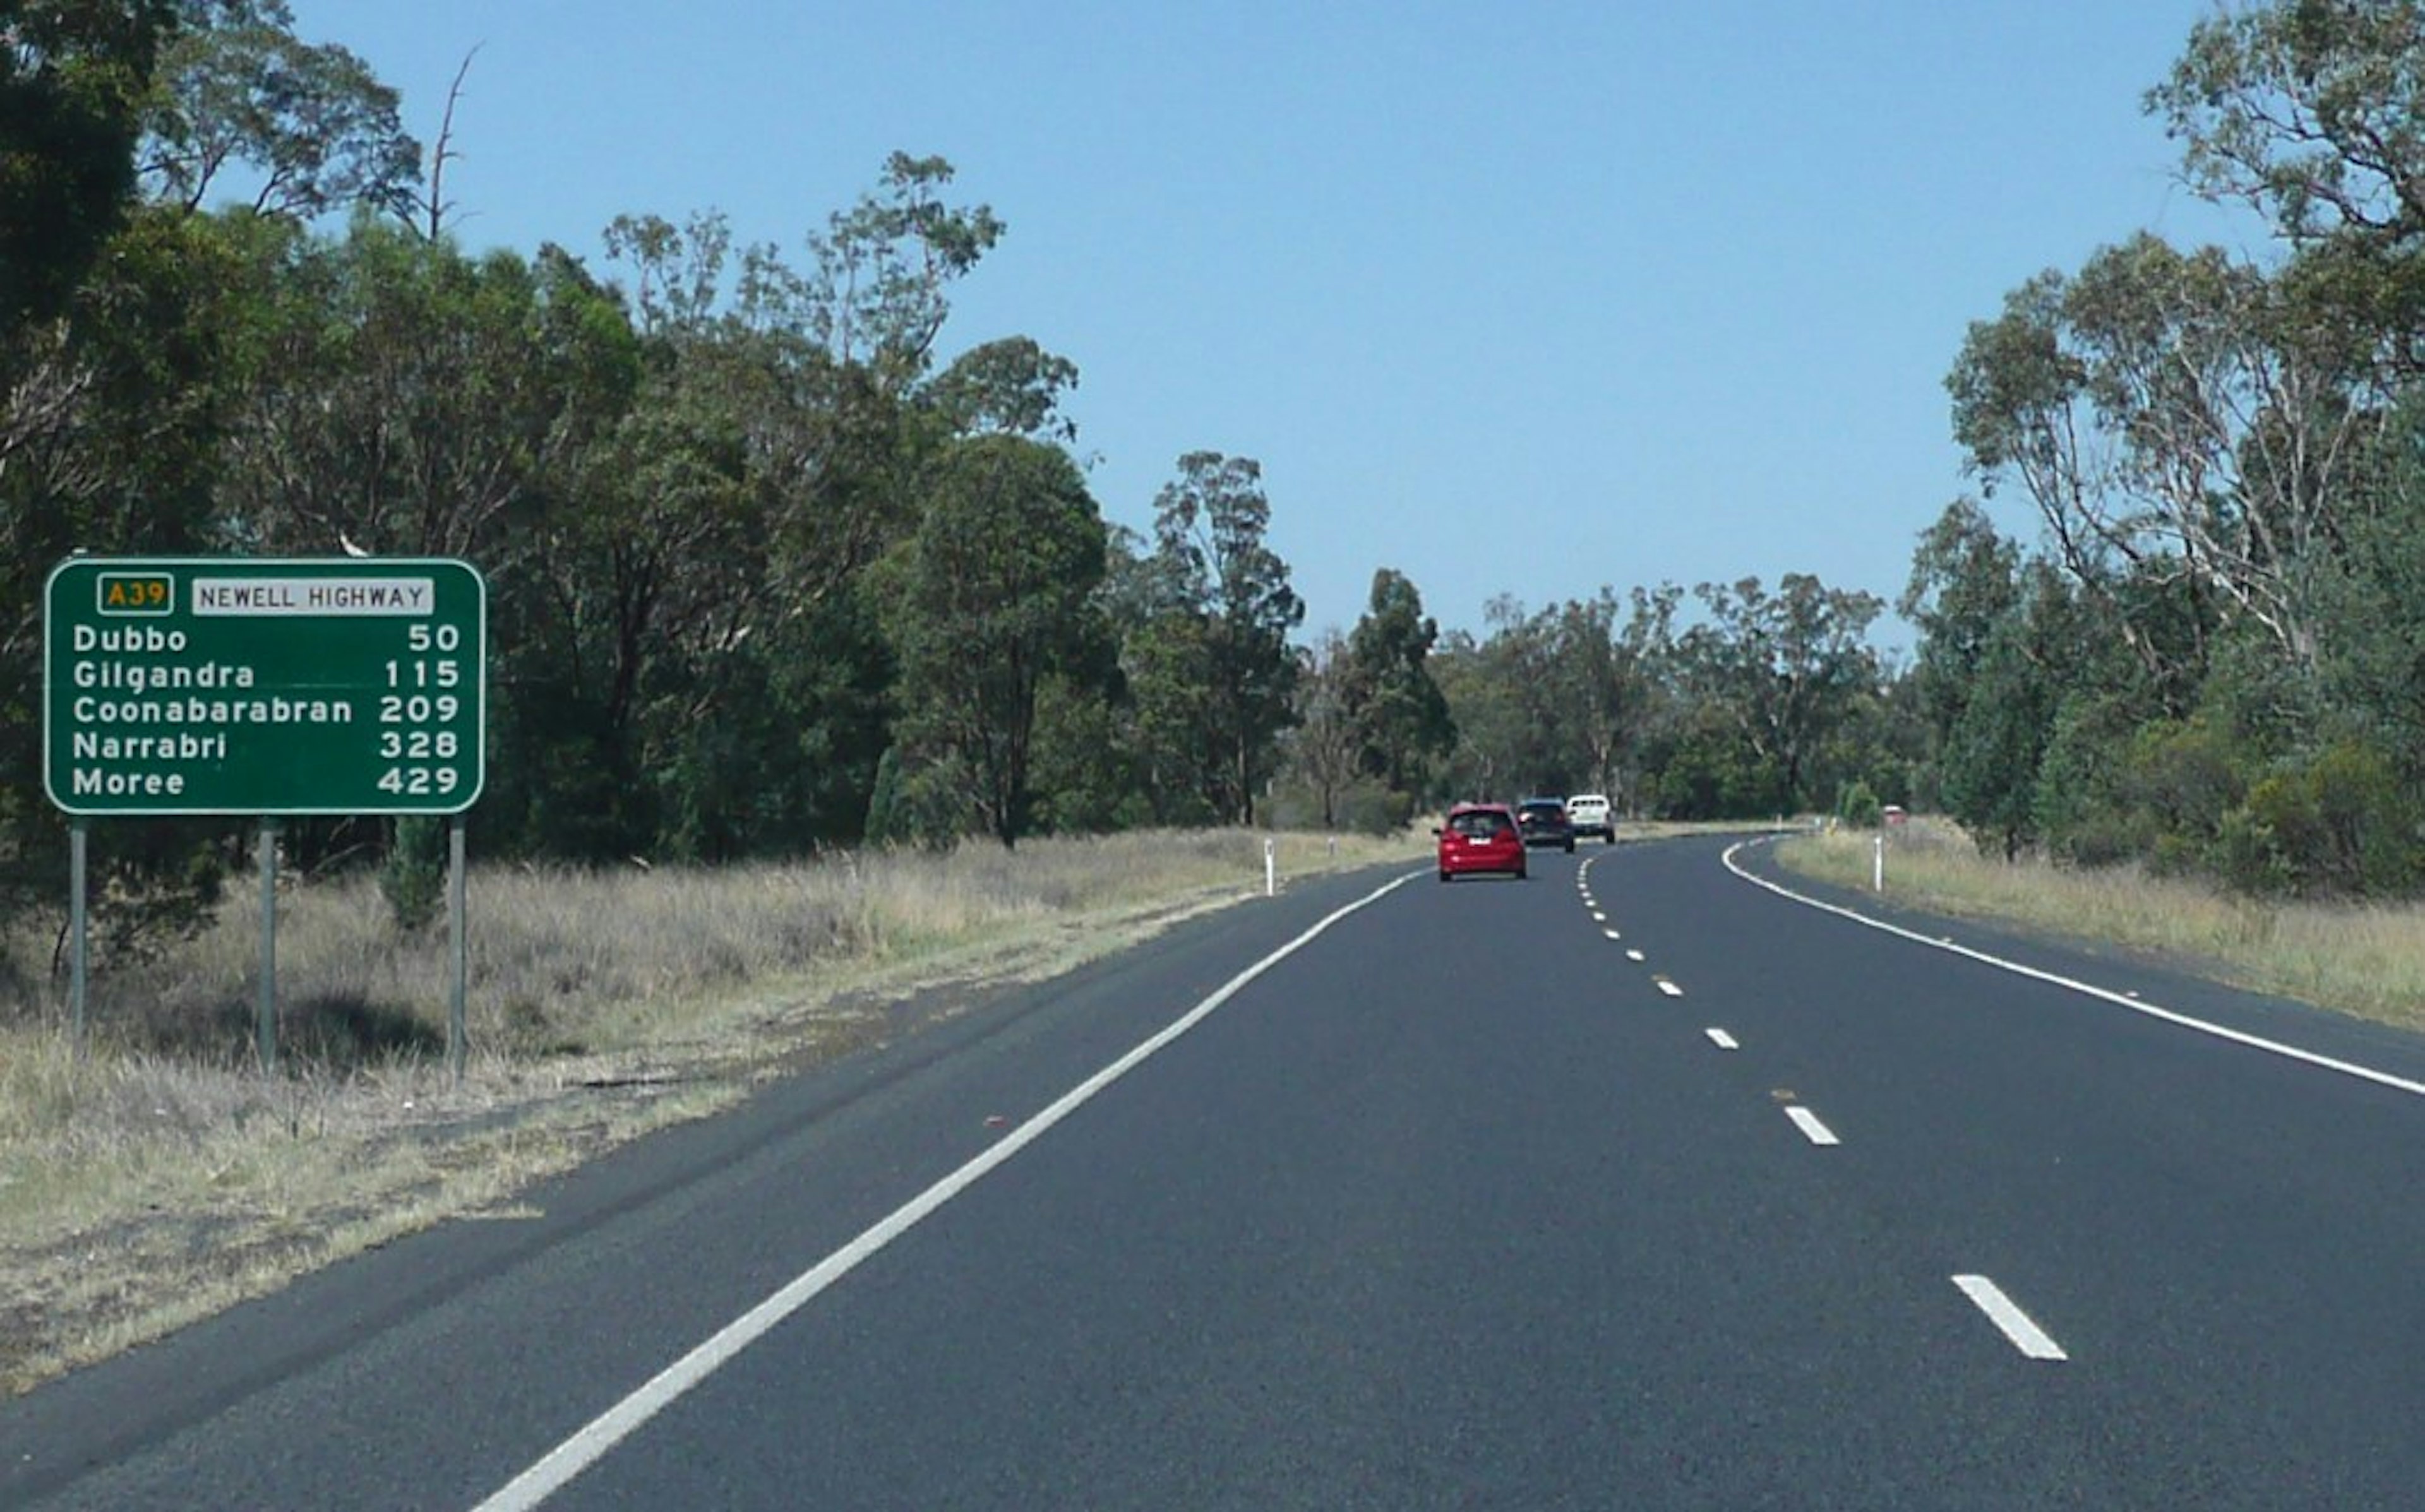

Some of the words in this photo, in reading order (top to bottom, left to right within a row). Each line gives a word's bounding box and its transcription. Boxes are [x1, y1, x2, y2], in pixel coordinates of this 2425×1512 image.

[108, 583, 165, 604] A39
[200, 587, 295, 607] NEWELL
[309, 587, 423, 607] HIGHWAY
[75, 625, 185, 651] Dubbo
[410, 624, 458, 651] 50
[75, 661, 253, 694] Gilgandra
[387, 660, 458, 687] 115
[75, 697, 351, 722] Coonabarabran
[381, 696, 458, 722] 209
[75, 732, 224, 758] Narrabri
[381, 732, 457, 758] 328
[74, 768, 183, 794] Moree
[378, 768, 457, 794] 429
